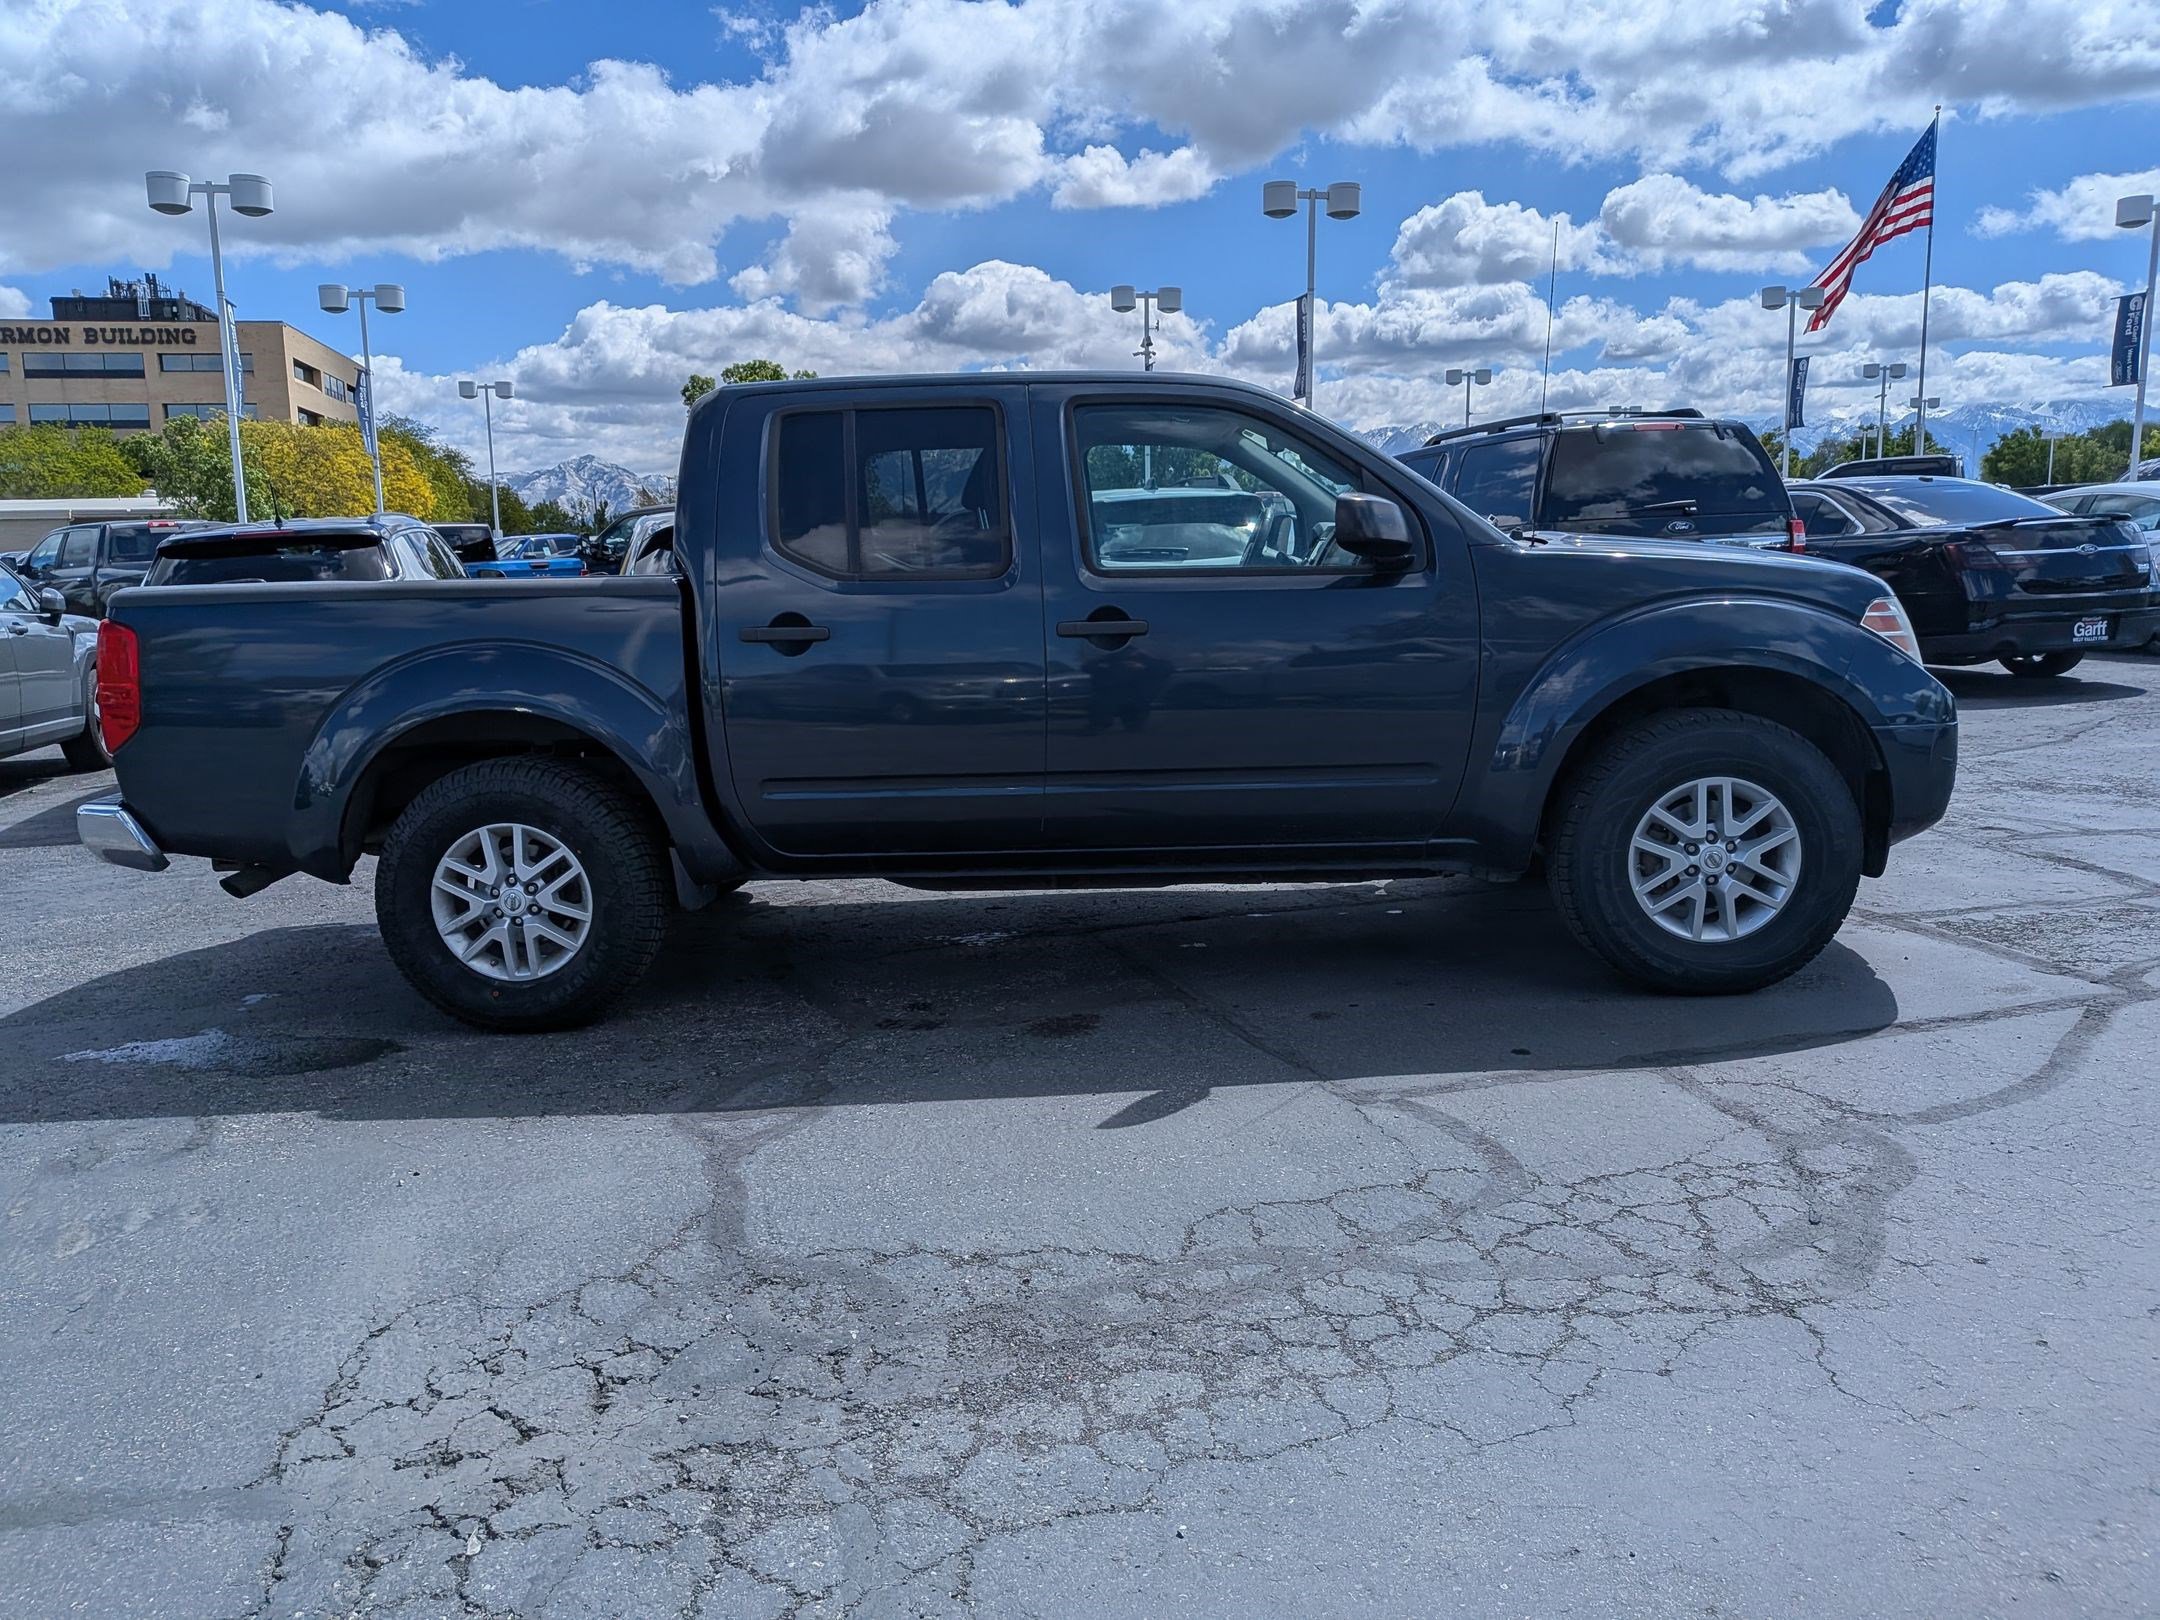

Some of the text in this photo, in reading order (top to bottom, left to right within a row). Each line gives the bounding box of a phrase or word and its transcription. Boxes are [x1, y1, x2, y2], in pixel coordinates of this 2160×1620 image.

[2125, 312, 2135, 336] Ford
[83, 326, 198, 346] BUILDING
[1673, 521, 1691, 531] Ford
[2073, 620, 2108, 637] Garff
